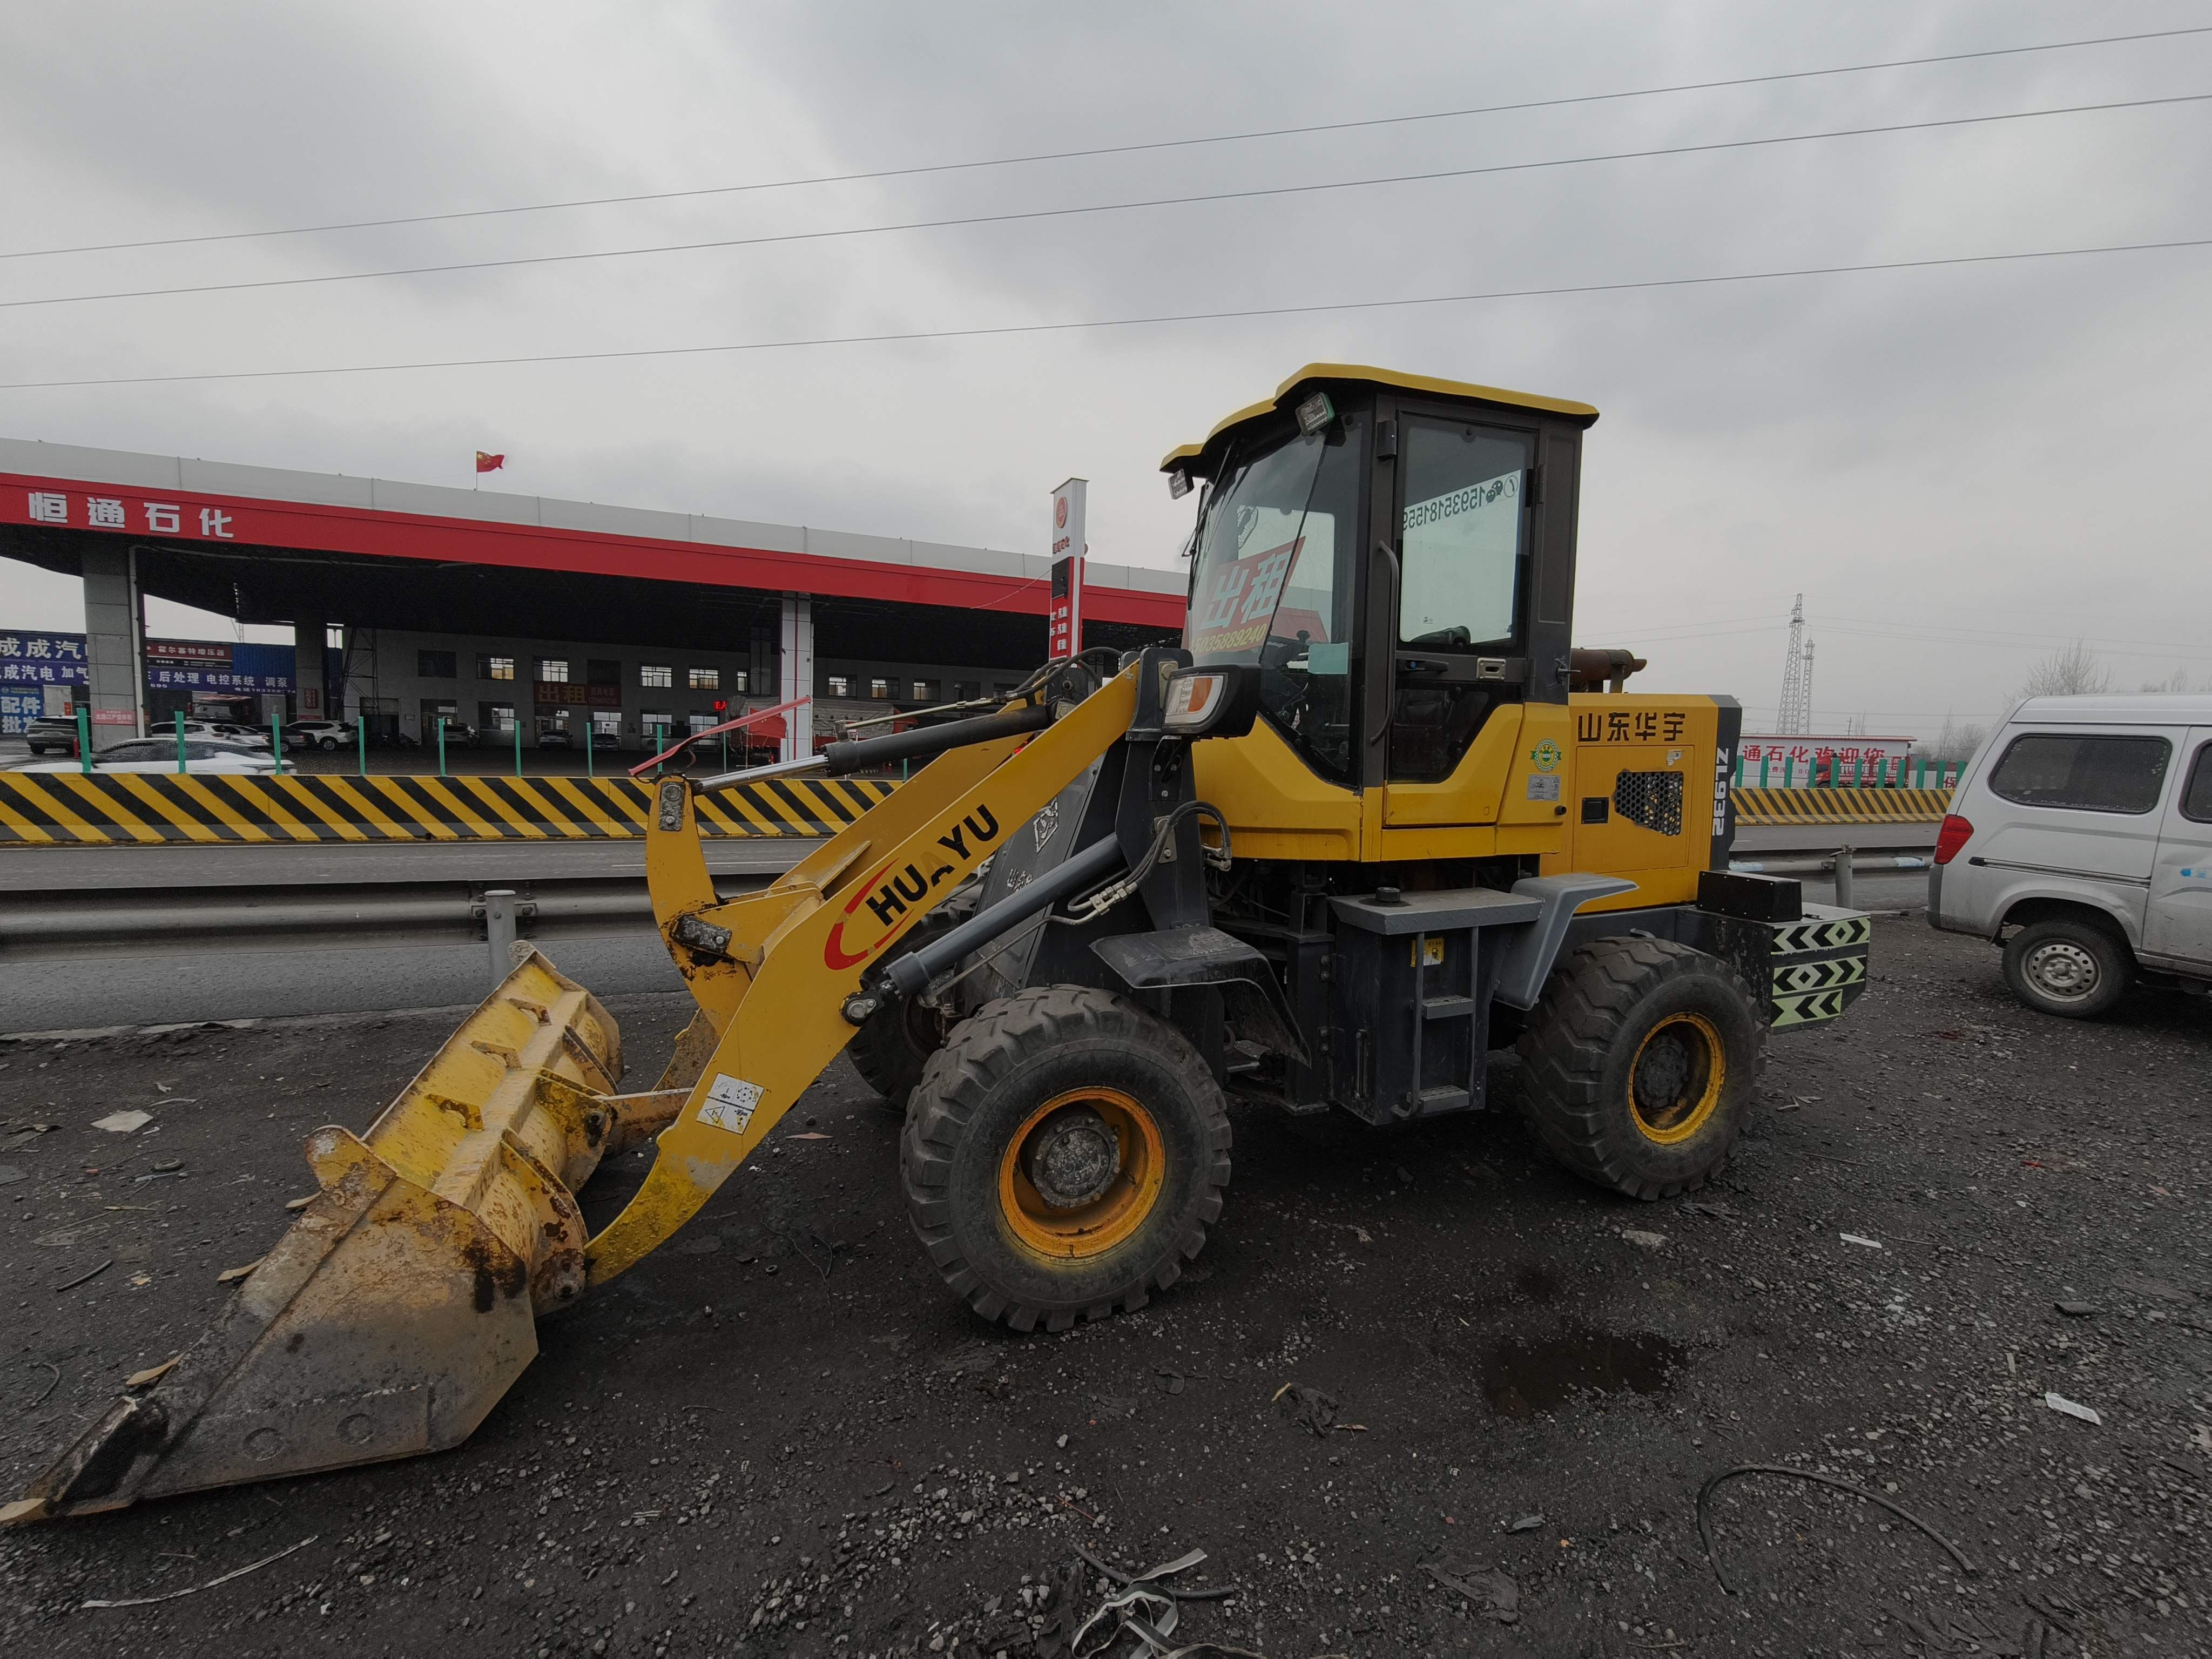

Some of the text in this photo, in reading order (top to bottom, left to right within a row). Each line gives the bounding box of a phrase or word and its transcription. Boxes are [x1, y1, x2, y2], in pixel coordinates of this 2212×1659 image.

[28, 492, 234, 538] 恒通石化
[1200, 550, 1292, 629] 出租
[0, 637, 88, 659] 成成汽
[159, 671, 199, 684] 后处理
[207, 674, 254, 686] 电控系统
[1, 697, 41, 714] 配件
[1578, 712, 1685, 742] 山东华宇
[1711, 748, 1728, 837] ZL932
